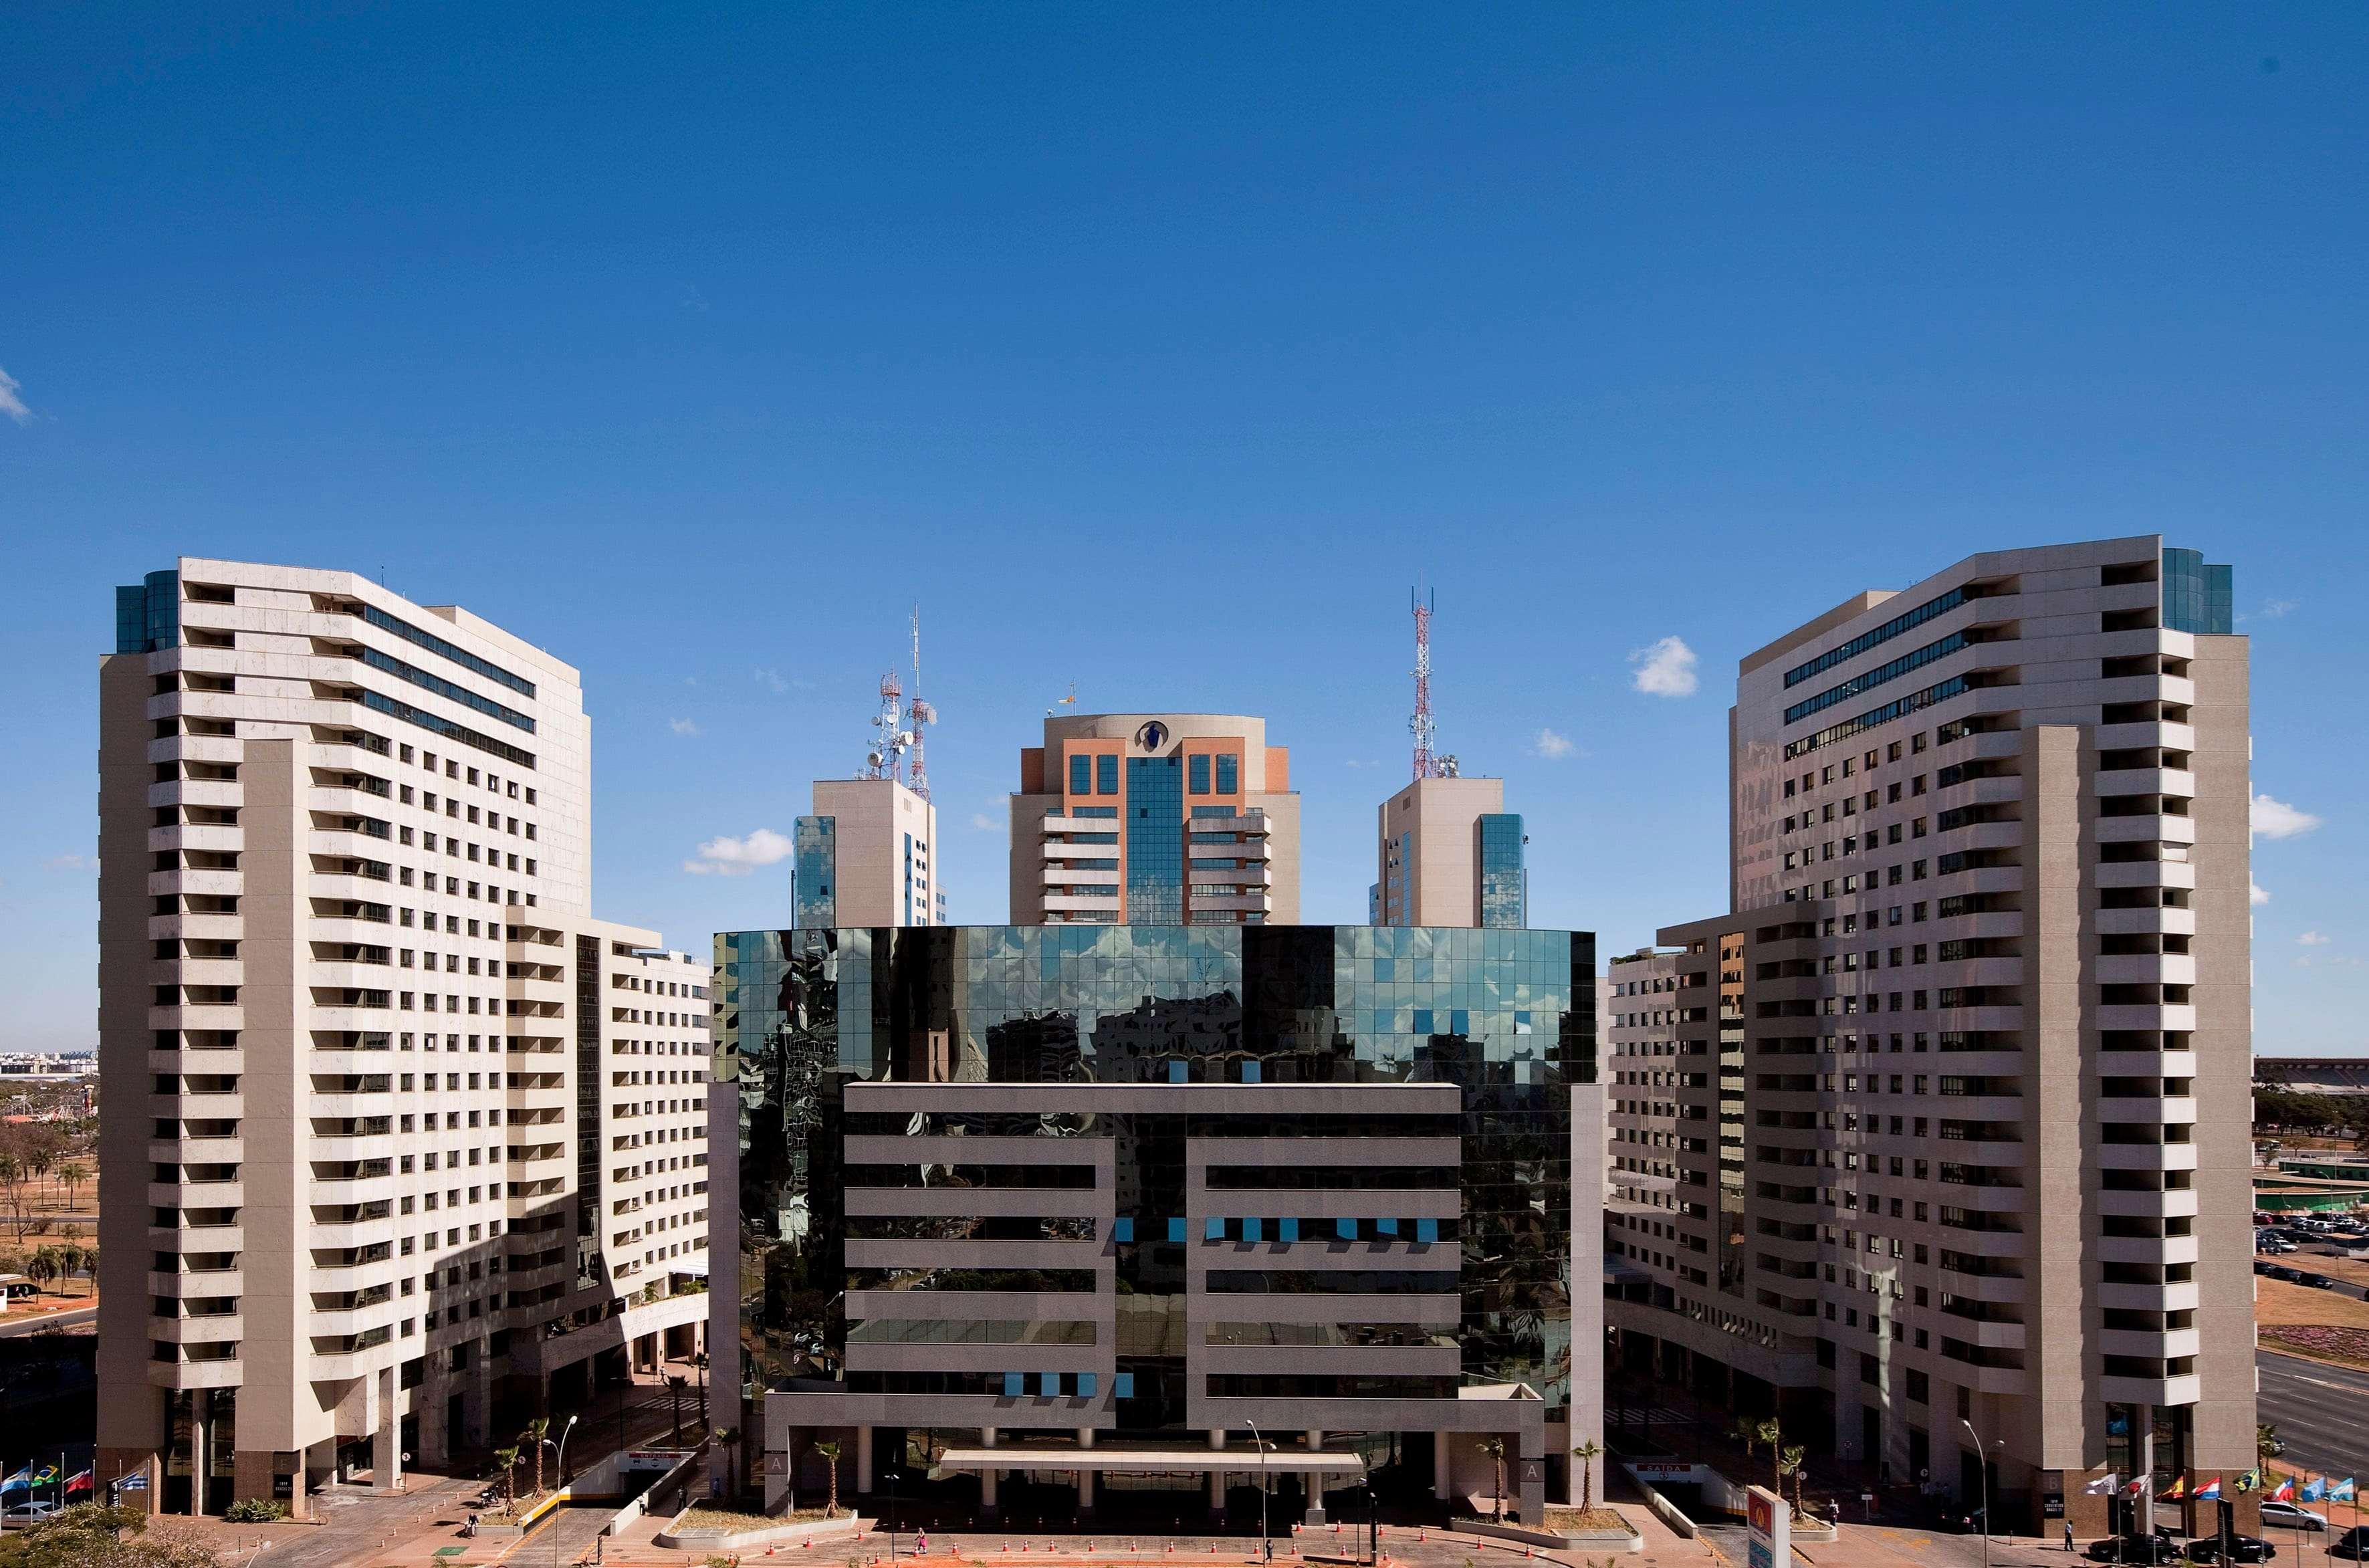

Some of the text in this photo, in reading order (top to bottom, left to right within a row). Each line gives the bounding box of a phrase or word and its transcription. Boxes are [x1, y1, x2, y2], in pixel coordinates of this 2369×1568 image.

[772, 1458, 781, 1470] A
[1527, 1465, 1537, 1477] A
[2049, 1476, 2057, 1490] B
